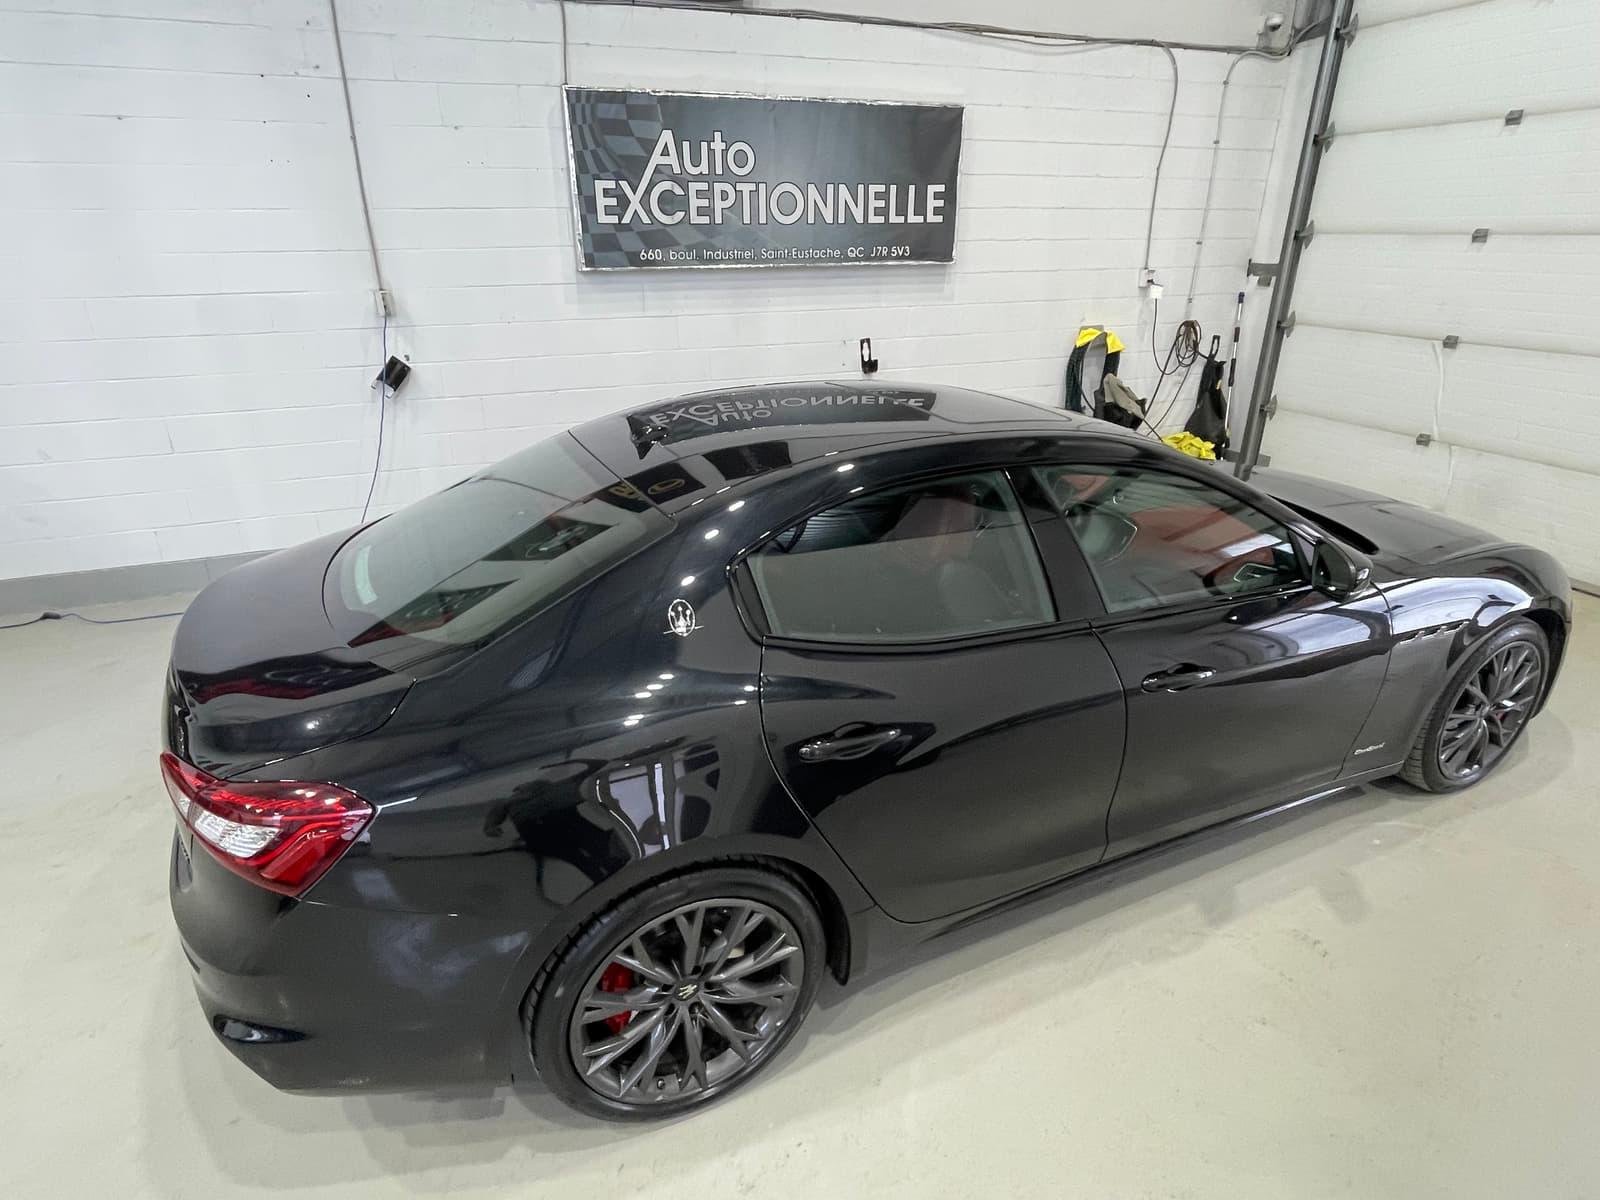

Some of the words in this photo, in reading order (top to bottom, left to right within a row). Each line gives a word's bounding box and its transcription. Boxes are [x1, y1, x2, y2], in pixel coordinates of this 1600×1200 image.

[646, 129, 756, 176] Auto
[594, 179, 946, 225] EXCEPTIONNELLE
[640, 248, 666, 262] 660,
[669, 248, 700, 261] boul.
[703, 248, 758, 261] Industriel,
[761, 247, 844, 260] Saint-Eustache,
[847, 246, 865, 258] QC
[870, 246, 888, 258] J7R
[891, 245, 911, 257] 5V3
